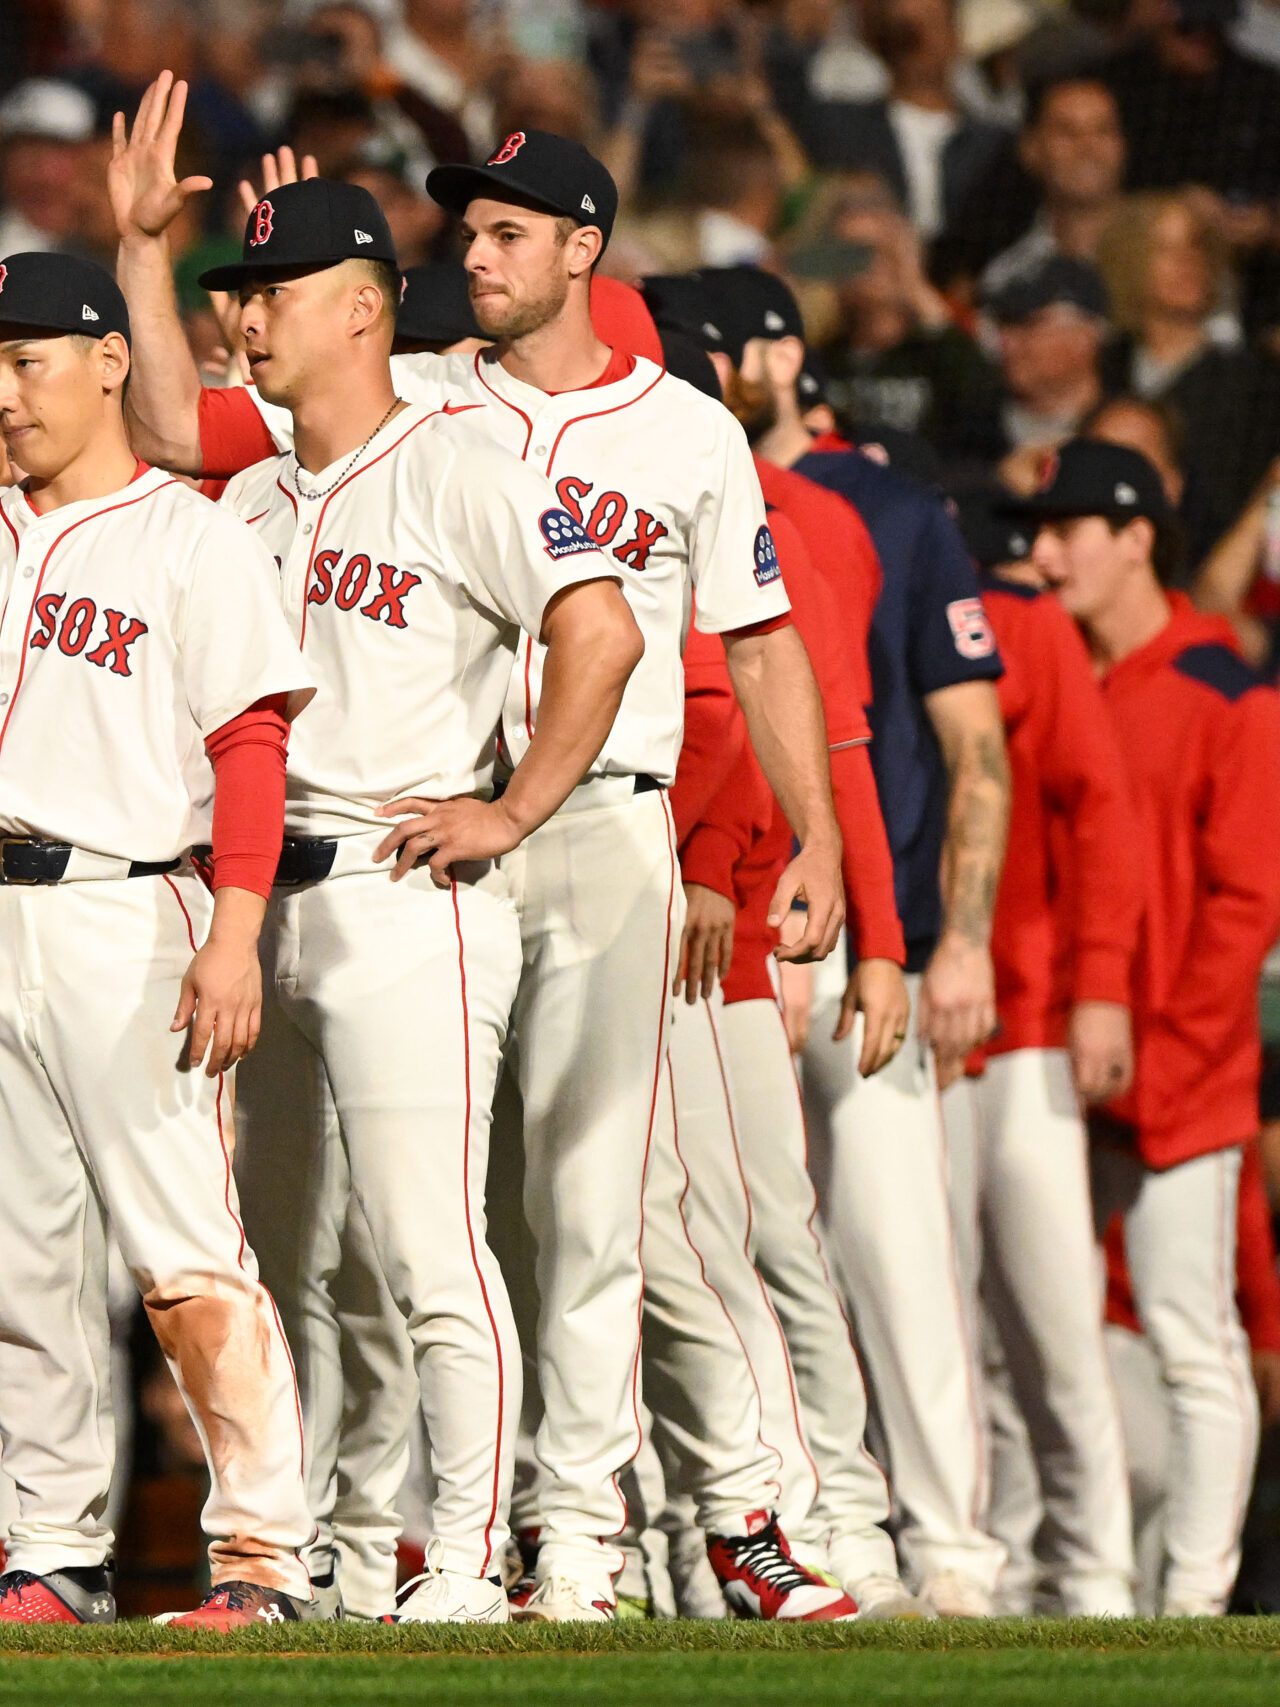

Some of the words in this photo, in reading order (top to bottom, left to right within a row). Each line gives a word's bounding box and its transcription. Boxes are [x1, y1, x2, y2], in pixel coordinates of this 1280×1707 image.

[486, 131, 526, 166] B
[250, 200, 275, 247] B
[555, 476, 668, 571] SOX
[308, 549, 422, 629] SOX
[30, 592, 149, 677] SOX
